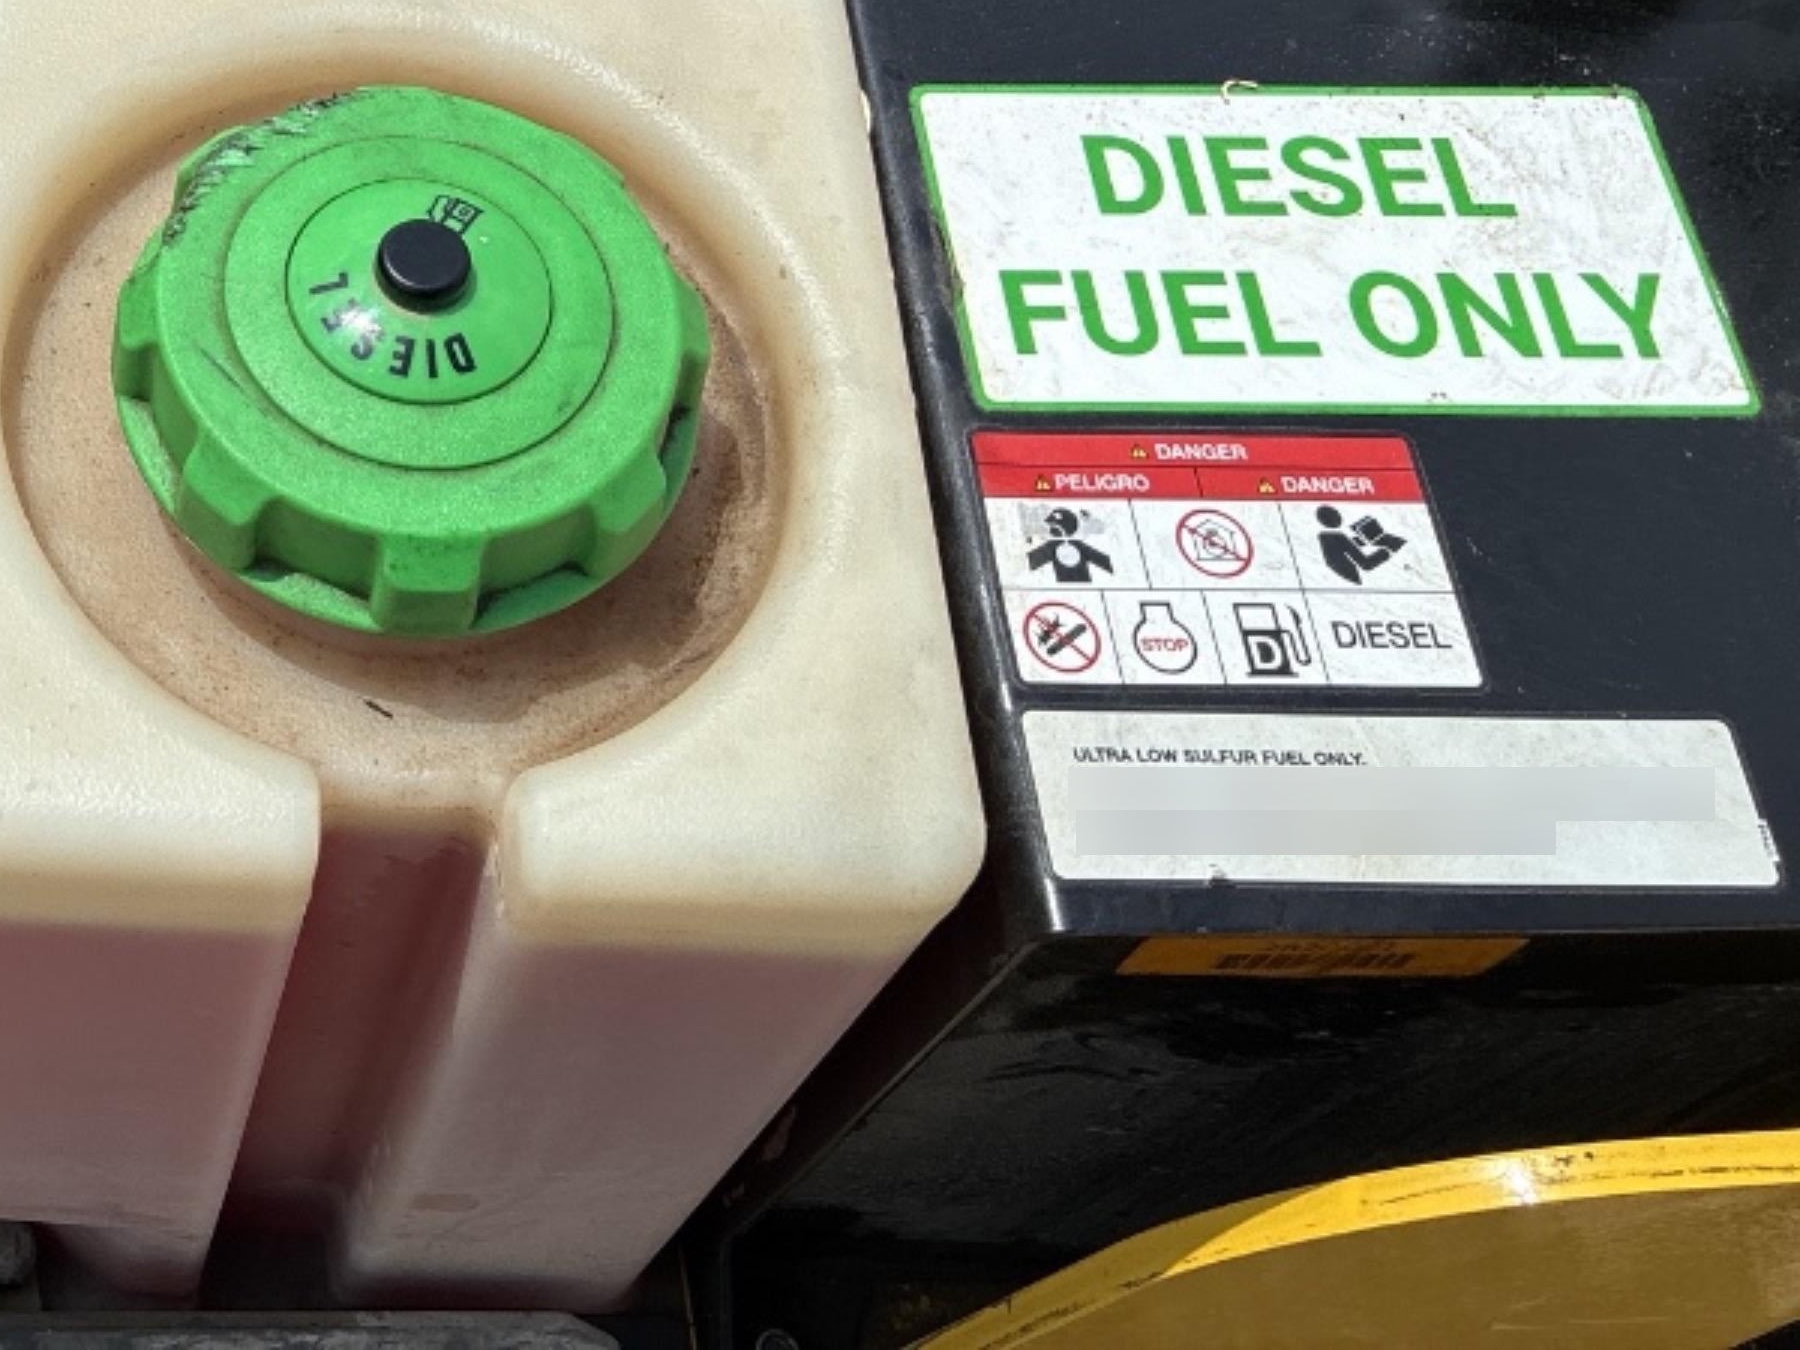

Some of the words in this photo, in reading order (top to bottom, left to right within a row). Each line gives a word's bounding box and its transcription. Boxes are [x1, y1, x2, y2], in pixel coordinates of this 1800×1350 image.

[1080, 134, 1516, 217] DIESEL
[998, 269, 1321, 356] FUEL
[1348, 271, 1660, 359] ONLY
[1153, 443, 1248, 460] DANGER
[1054, 473, 1150, 492] PELIGRO
[1280, 476, 1375, 494] DANGER
[1331, 619, 1454, 650] DIESEL
[1140, 638, 1189, 652] STOP
[1073, 747, 1133, 763] ULTRA
[1136, 749, 1177, 763] LOW
[1184, 750, 1259, 764] SULFUR
[1261, 751, 1311, 765] FUEL
